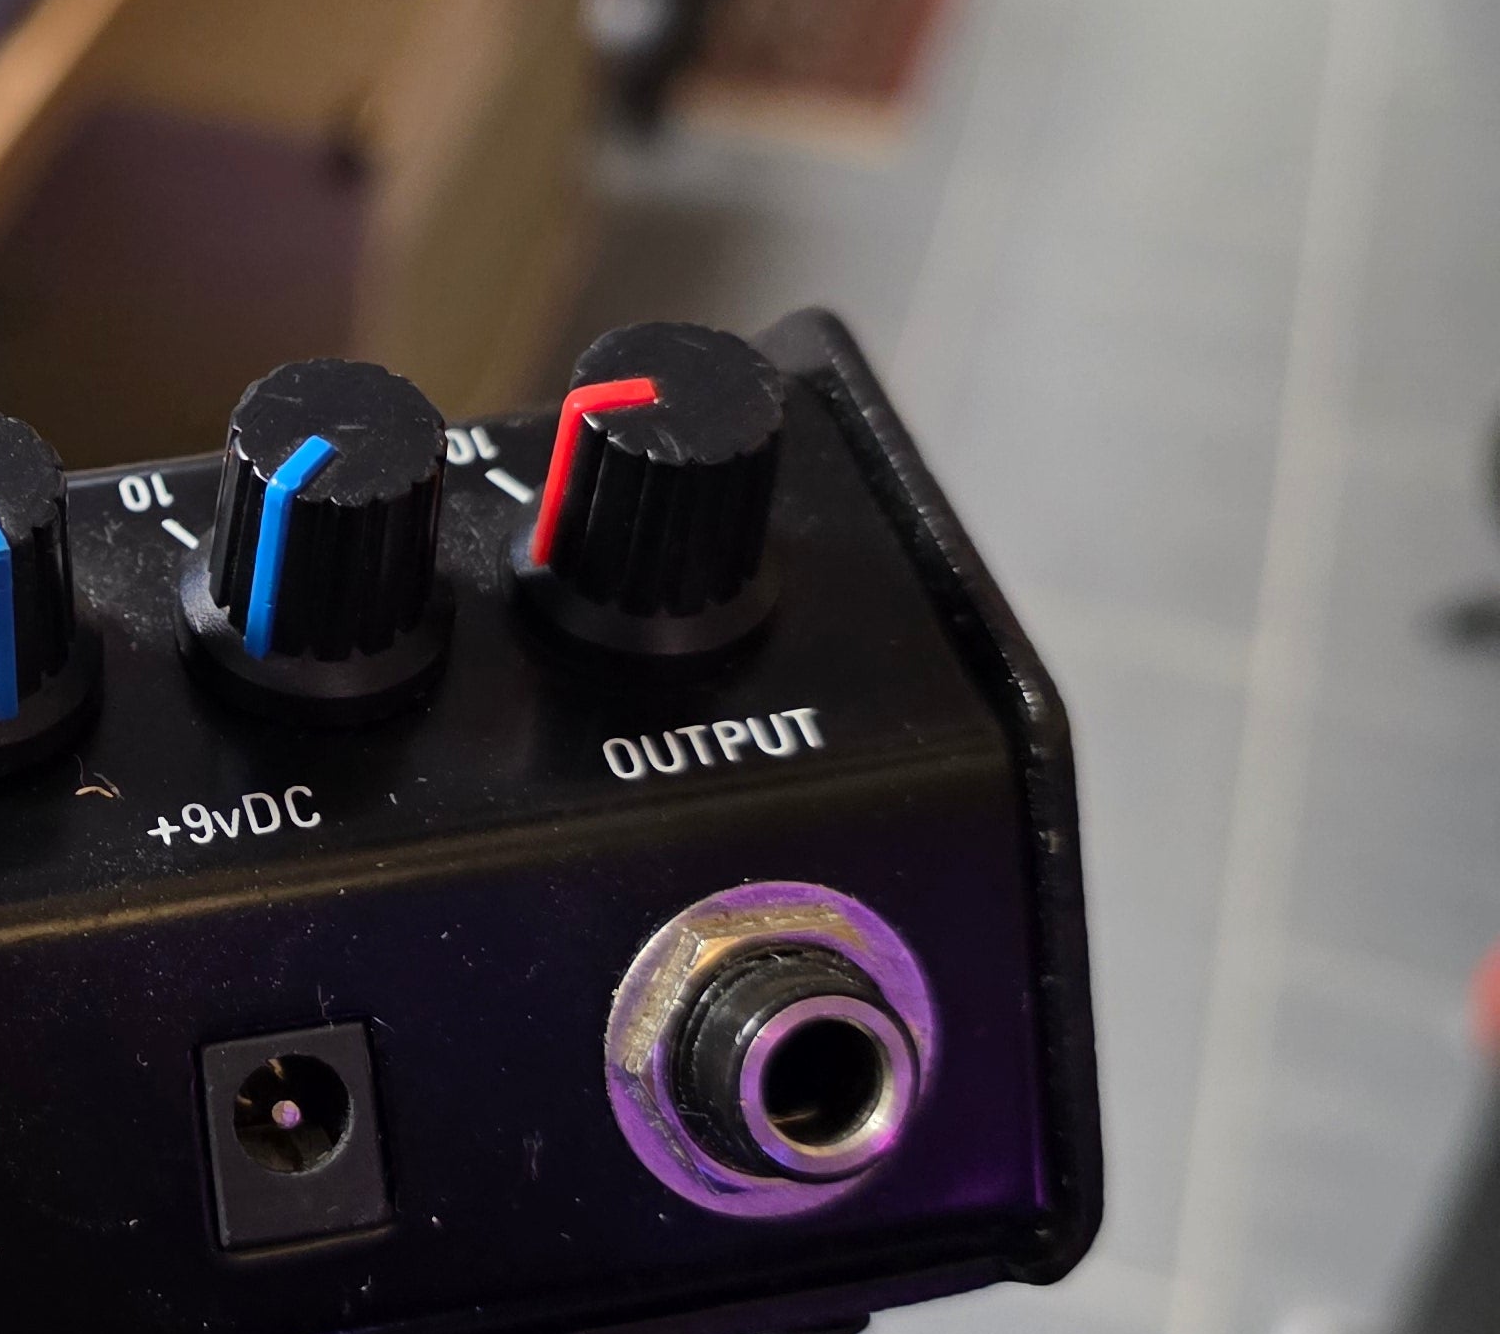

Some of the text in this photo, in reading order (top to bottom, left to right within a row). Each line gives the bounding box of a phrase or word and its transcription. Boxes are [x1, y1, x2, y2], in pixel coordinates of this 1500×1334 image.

[118, 472, 174, 513] 10
[602, 707, 825, 781] OUTPUT
[146, 785, 321, 846] +9vDC
